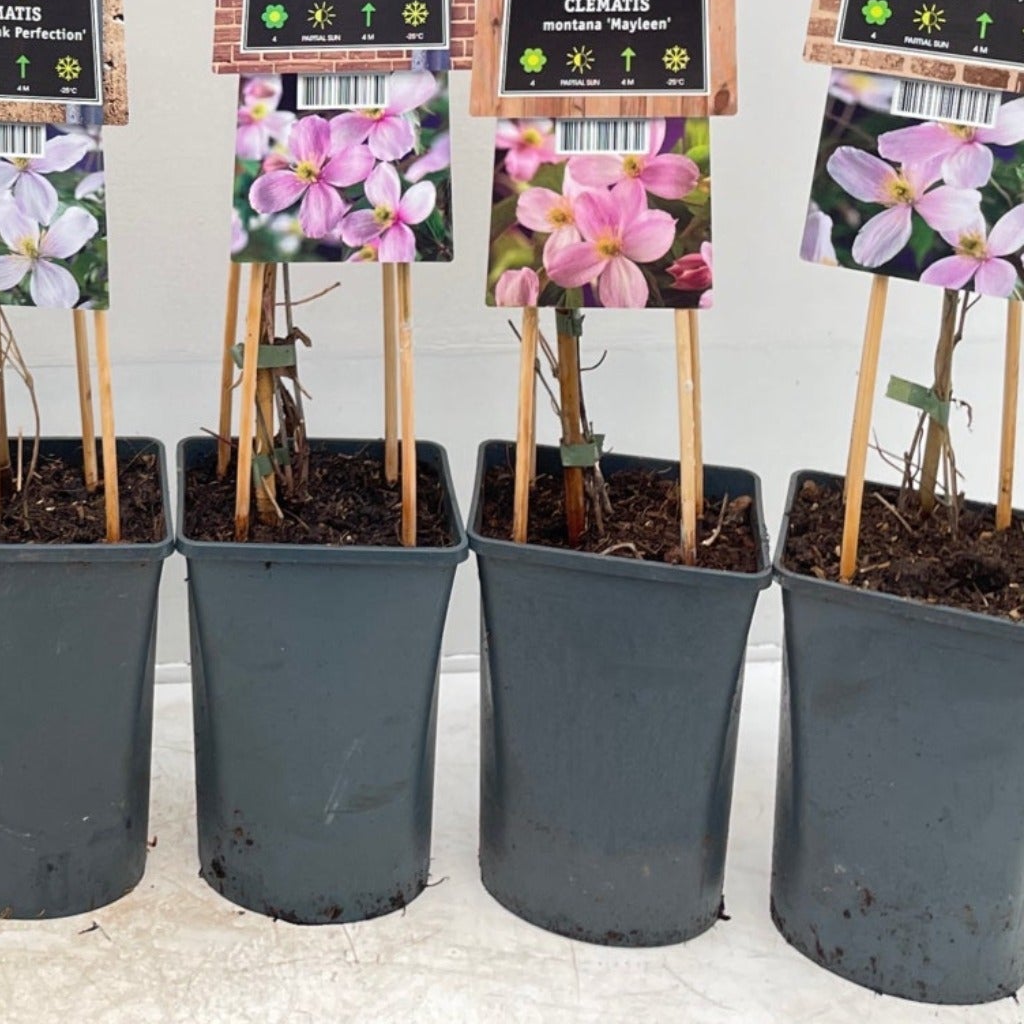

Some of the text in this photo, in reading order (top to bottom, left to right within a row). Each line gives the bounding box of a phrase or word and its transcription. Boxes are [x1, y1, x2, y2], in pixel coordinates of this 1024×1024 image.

[542, 17, 672, 33] montana 'Mayleen'
[15, 27, 86, 41] Perfection'
[904, 36, 949, 48] PARTIAL SUN
